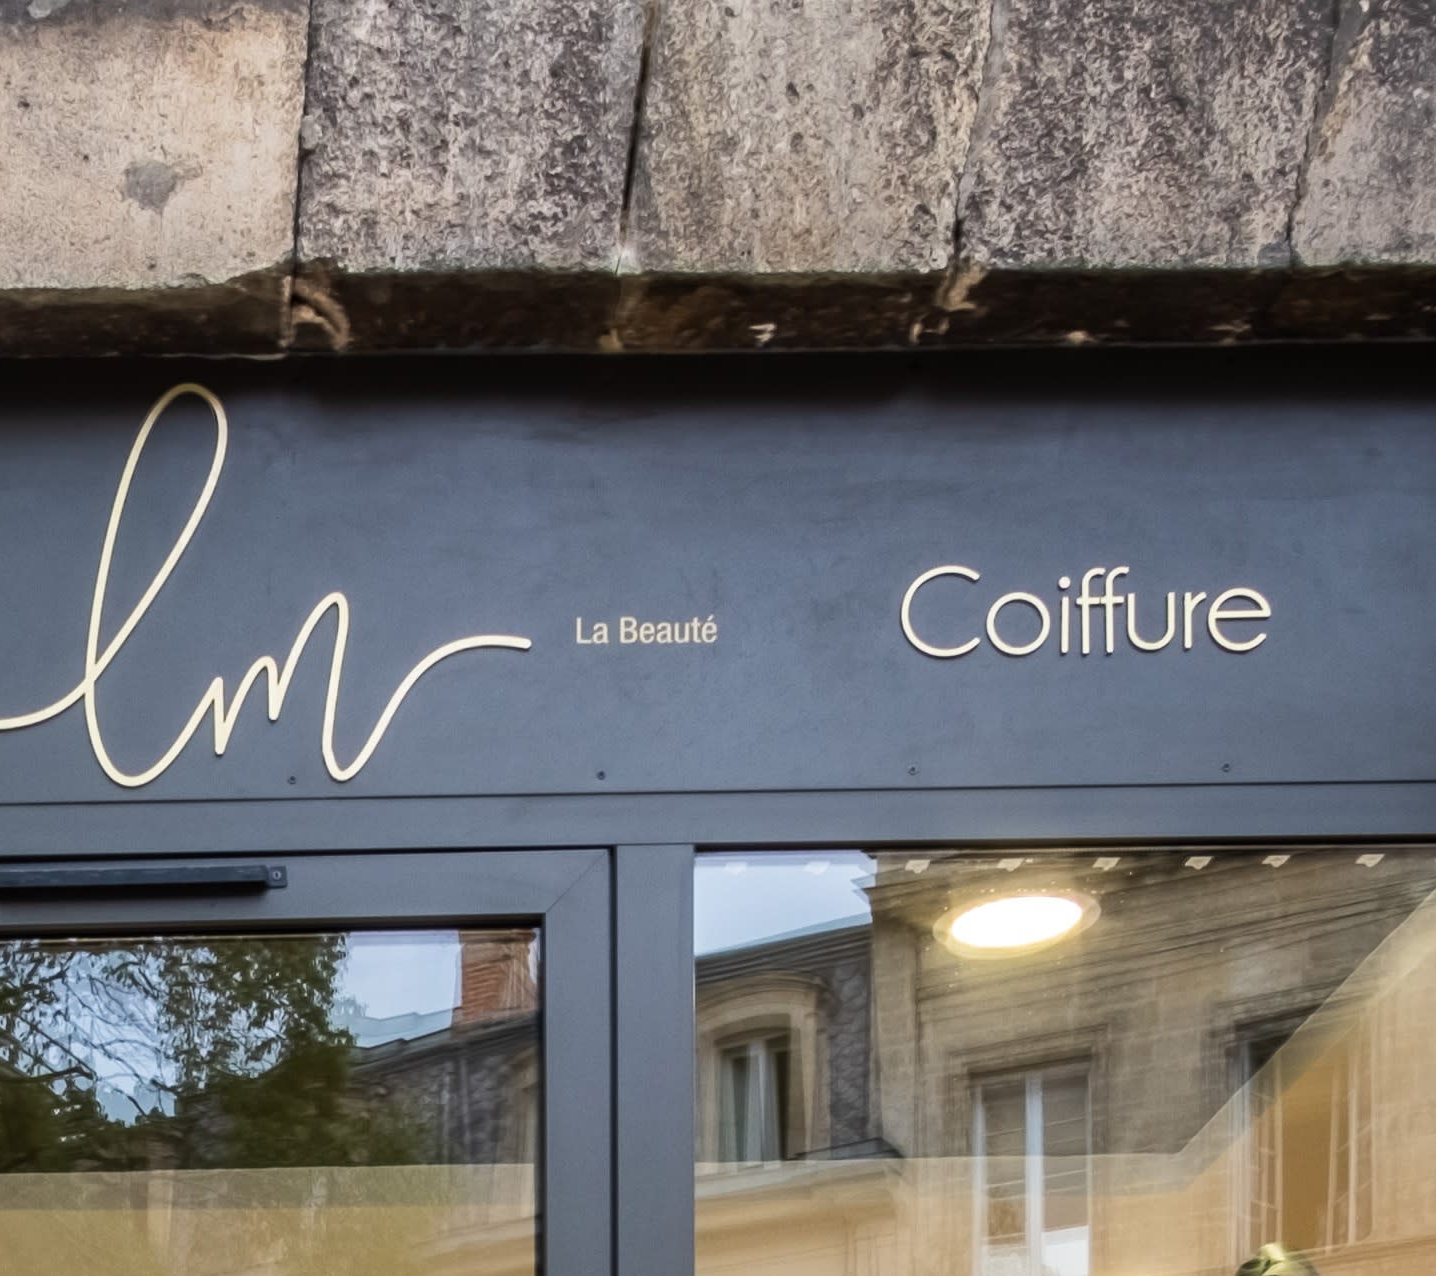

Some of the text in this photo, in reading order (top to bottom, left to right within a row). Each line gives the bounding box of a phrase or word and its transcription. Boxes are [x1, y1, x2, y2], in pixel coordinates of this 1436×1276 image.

[576, 614, 719, 645] La Beauté
[901, 564, 1272, 658] Coiffure
